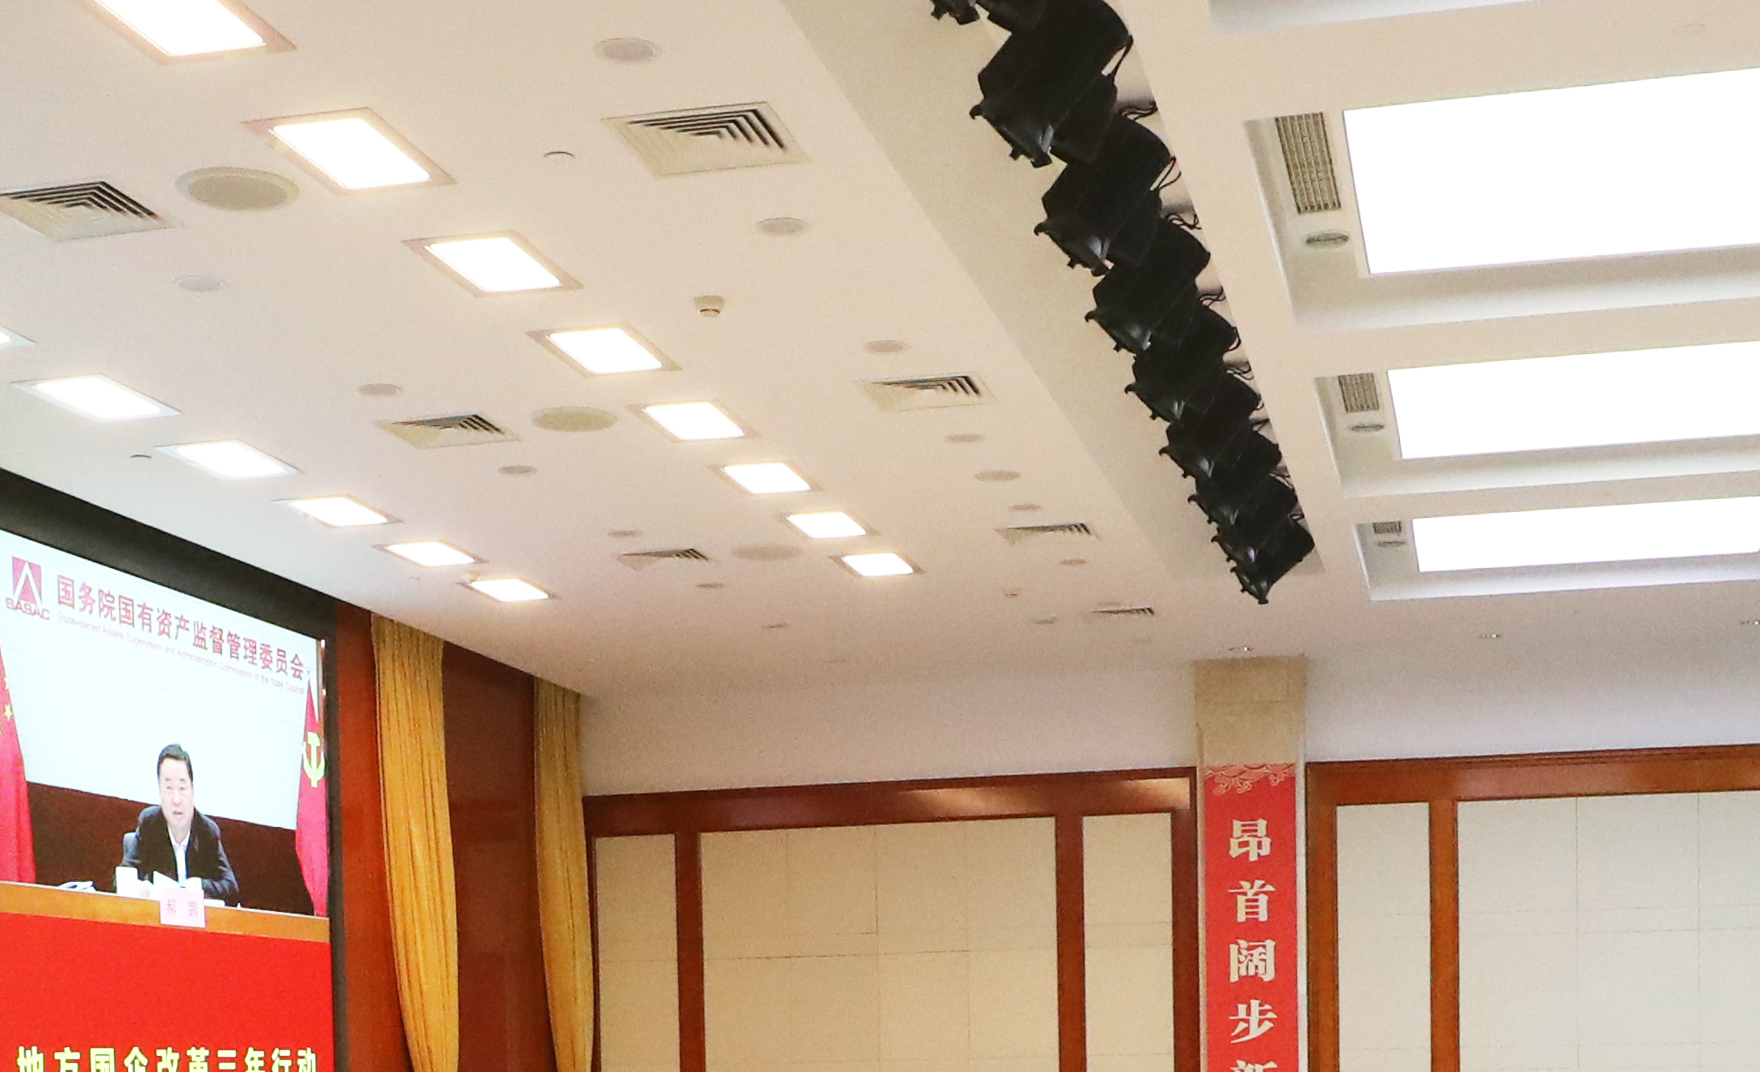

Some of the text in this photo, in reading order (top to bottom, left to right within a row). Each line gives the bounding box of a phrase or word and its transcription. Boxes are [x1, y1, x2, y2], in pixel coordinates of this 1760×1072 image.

[57, 574, 304, 681] 国务院国有资产监督管理委员会
